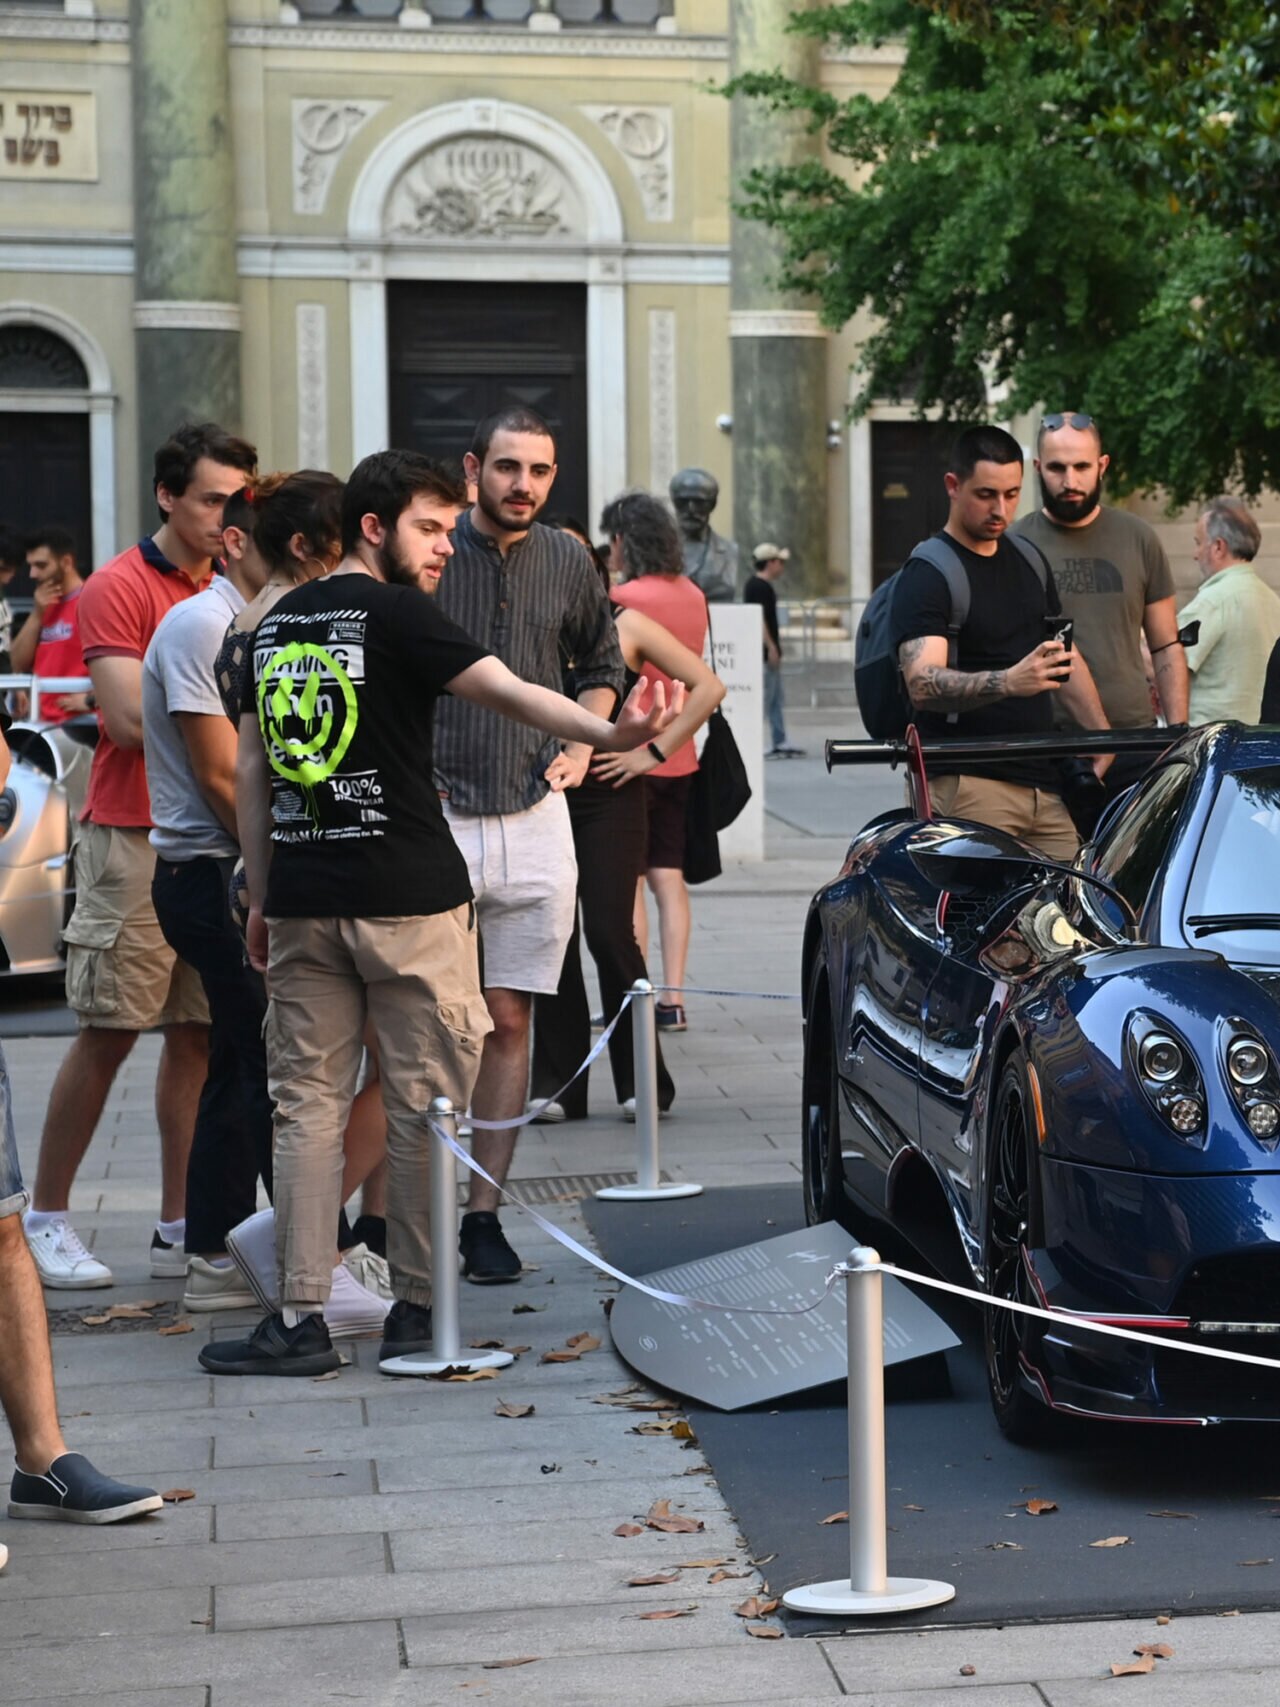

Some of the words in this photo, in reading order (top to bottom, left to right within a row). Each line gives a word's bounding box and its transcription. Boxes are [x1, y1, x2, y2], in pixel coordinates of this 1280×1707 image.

[1062, 558, 1091, 570] THE
[1053, 570, 1094, 583] ORTH
[328, 776, 382, 798] 100%
